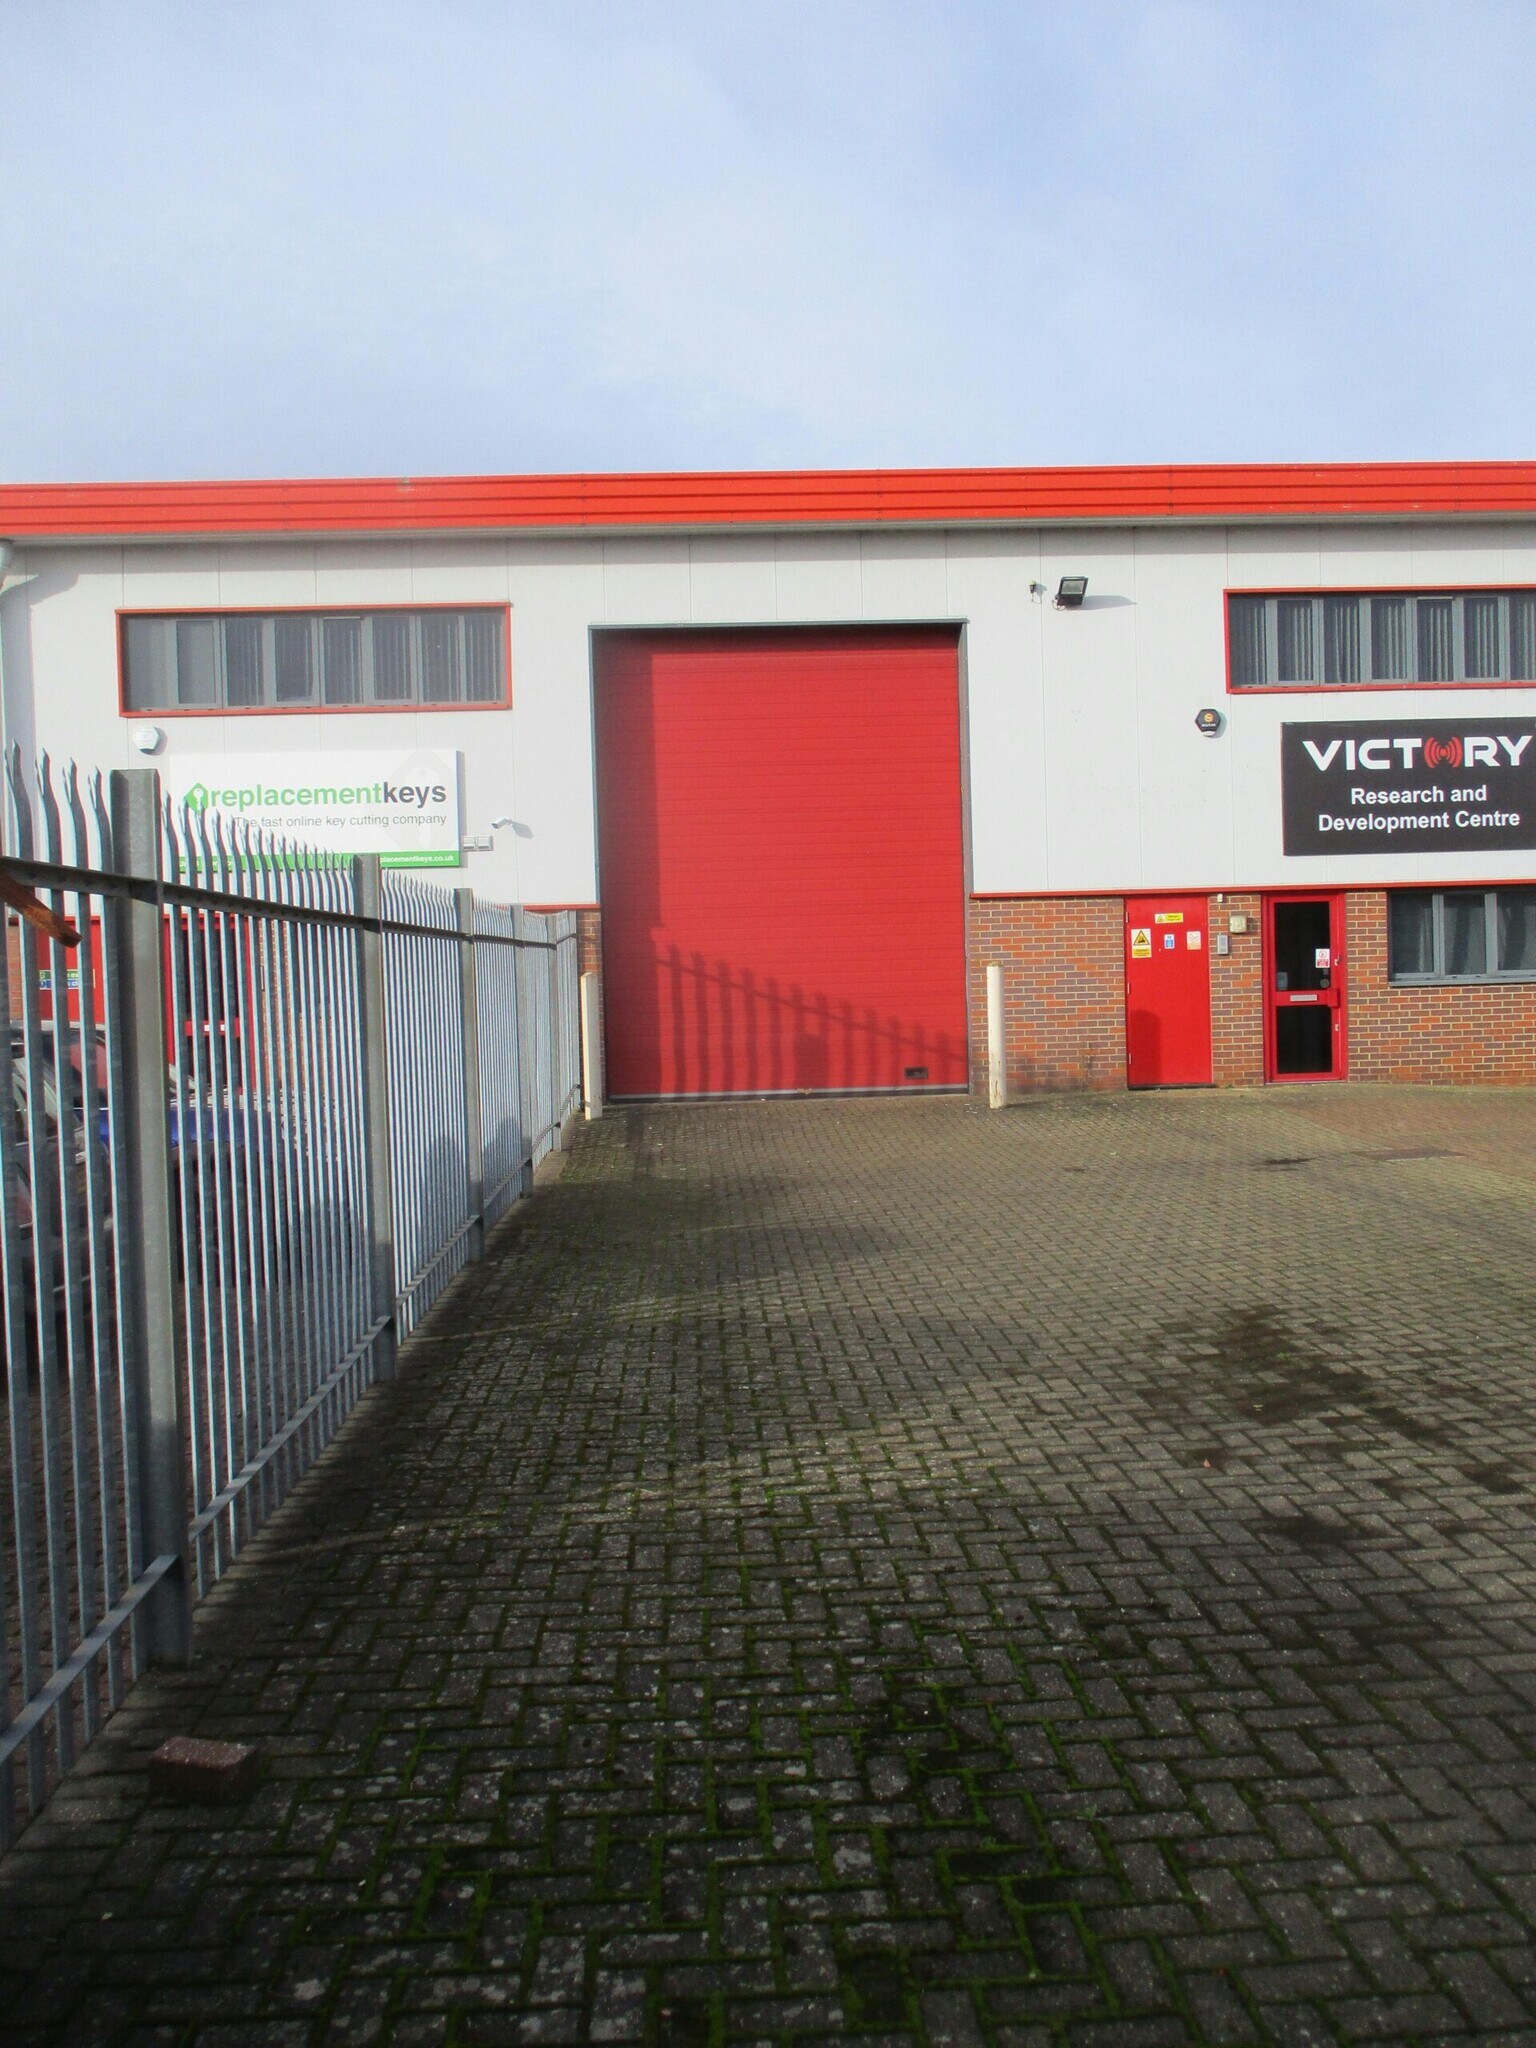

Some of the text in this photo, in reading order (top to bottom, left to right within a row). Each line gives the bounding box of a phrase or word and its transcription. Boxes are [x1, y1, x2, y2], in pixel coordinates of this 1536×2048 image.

[1302, 735, 1533, 772] VICTORY
[211, 781, 447, 812] replacementkeys
[1350, 784, 1487, 805] Research and
[261, 816, 283, 828] fast
[286, 815, 322, 828] online
[326, 815, 345, 828] key
[349, 814, 389, 828] cutting
[392, 814, 447, 828] company
[1318, 810, 1520, 833] Development Centre
